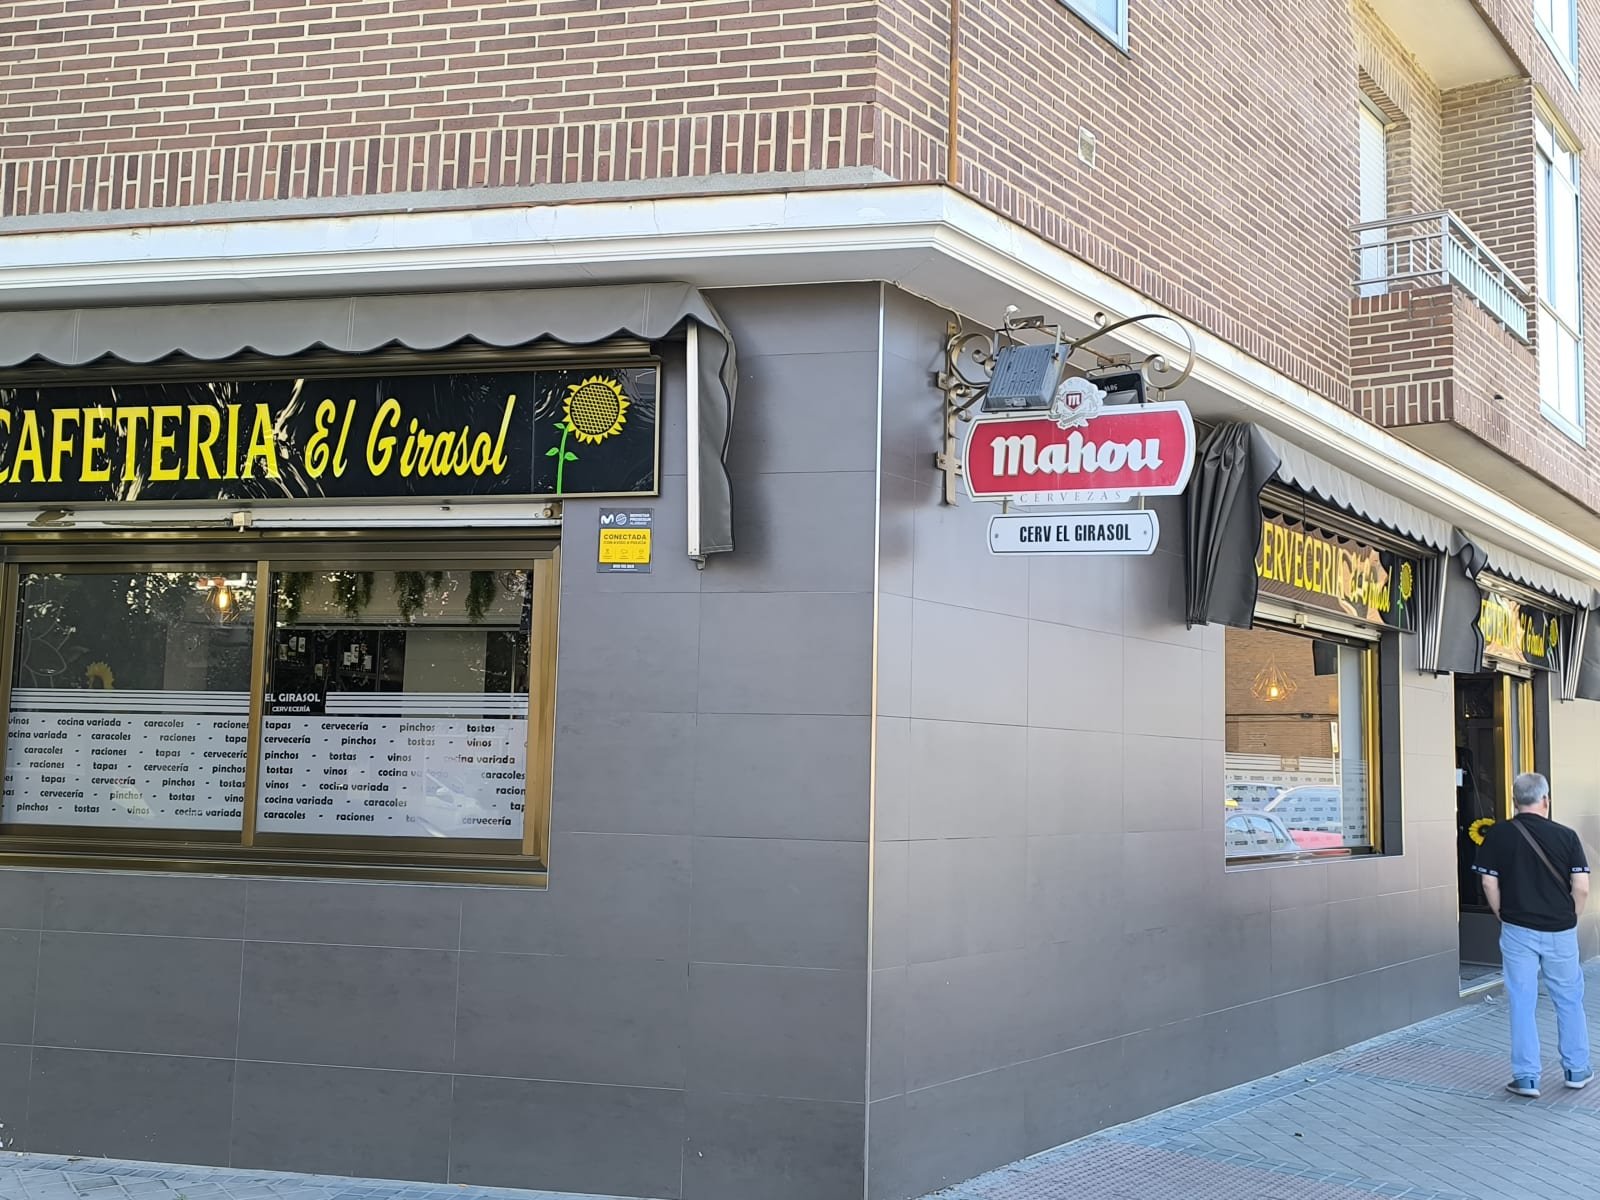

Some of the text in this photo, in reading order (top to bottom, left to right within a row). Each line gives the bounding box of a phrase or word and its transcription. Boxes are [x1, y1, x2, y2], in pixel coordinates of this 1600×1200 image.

[305, 398, 356, 478] El
[366, 395, 516, 477] Girasol
[1020, 490, 1122, 504] CERVEZAS
[1019, 523, 1132, 543] CERV EL GIRASOL
[1255, 520, 1345, 600] ERVECERIA
[264, 693, 321, 702] EL GIRASOL
[8, 716, 30, 726] vinos
[57, 717, 85, 727] cocina
[87, 718, 122, 727] variada
[143, 719, 185, 728] caracoles
[265, 721, 496, 733] tapas cervecería pinchos tostas
[33, 730, 68, 740] variada
[91, 732, 132, 741] caracoles
[159, 733, 196, 742] raciones
[264, 735, 493, 747] cervecería pinchos tostas vinos
[24, 745, 64, 755] caracoles
[91, 747, 127, 756] raciones
[155, 749, 181, 759] tapas
[264, 750, 299, 760] pinchos
[329, 752, 357, 761] tostas
[387, 753, 412, 762] vinos
[476, 755, 516, 765] variada
[29, 760, 246, 775] raciones tapas cervecería pinchos
[266, 765, 293, 775] tostas
[323, 766, 348, 776] vinos
[378, 767, 408, 778] cocina
[481, 770, 525, 780] caracoles
[41, 774, 66, 785] tapas
[91, 776, 136, 785] cervecería
[161, 777, 196, 788] pinchos
[219, 779, 246, 788] tostas
[265, 780, 289, 789] vinos
[319, 782, 349, 791] cocina
[351, 782, 389, 792] variada
[40, 788, 84, 798] cervecería
[110, 790, 144, 801] pinchos
[169, 792, 196, 801] tostas
[264, 795, 294, 804] cocina
[295, 796, 334, 806] variada
[363, 798, 408, 807] caracoles
[16, 802, 242, 818] pinchos tostas vinos cocina variada
[263, 810, 512, 826] caracoles raciones cervecería
